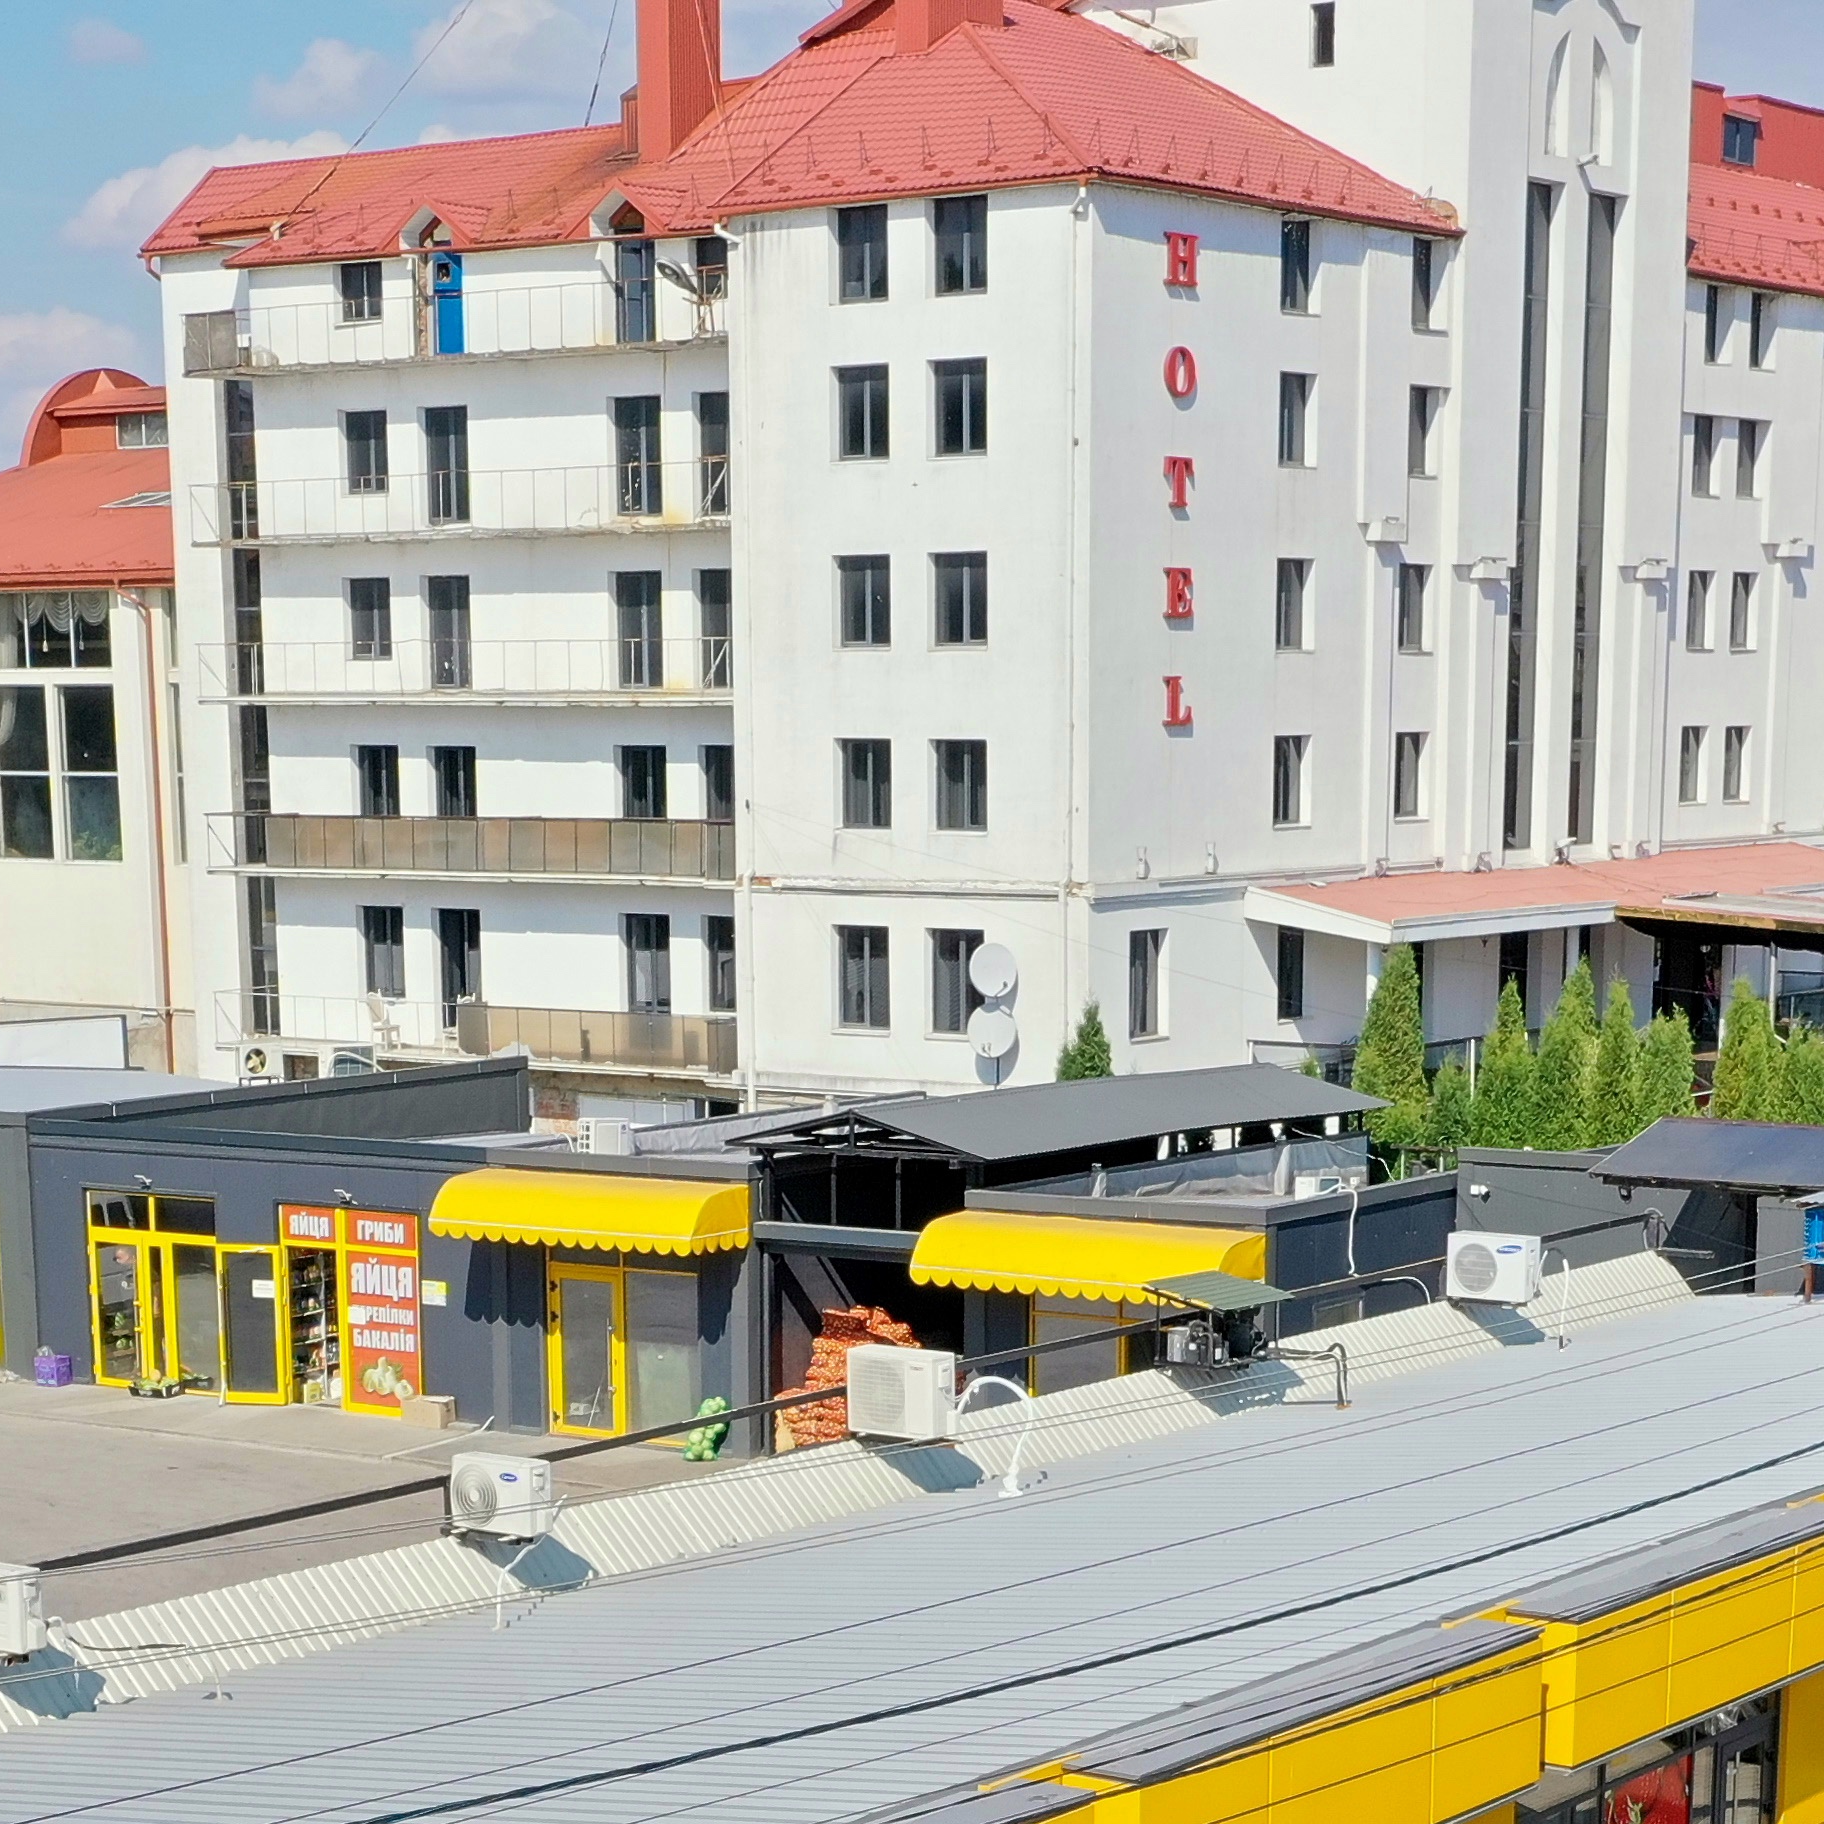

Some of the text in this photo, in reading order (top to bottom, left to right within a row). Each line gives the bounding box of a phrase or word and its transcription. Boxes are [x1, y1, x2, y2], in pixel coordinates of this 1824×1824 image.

[1162, 231, 1200, 727] HOTEL
[289, 1211, 330, 1240] ЯЙЦЯ
[357, 1219, 406, 1245] ГРИБИ
[351, 1257, 414, 1302] ЯЙЦЯ
[350, 1303, 415, 1327] РЕПІЛКИ
[353, 1328, 416, 1353] БАКАЛІЯ
